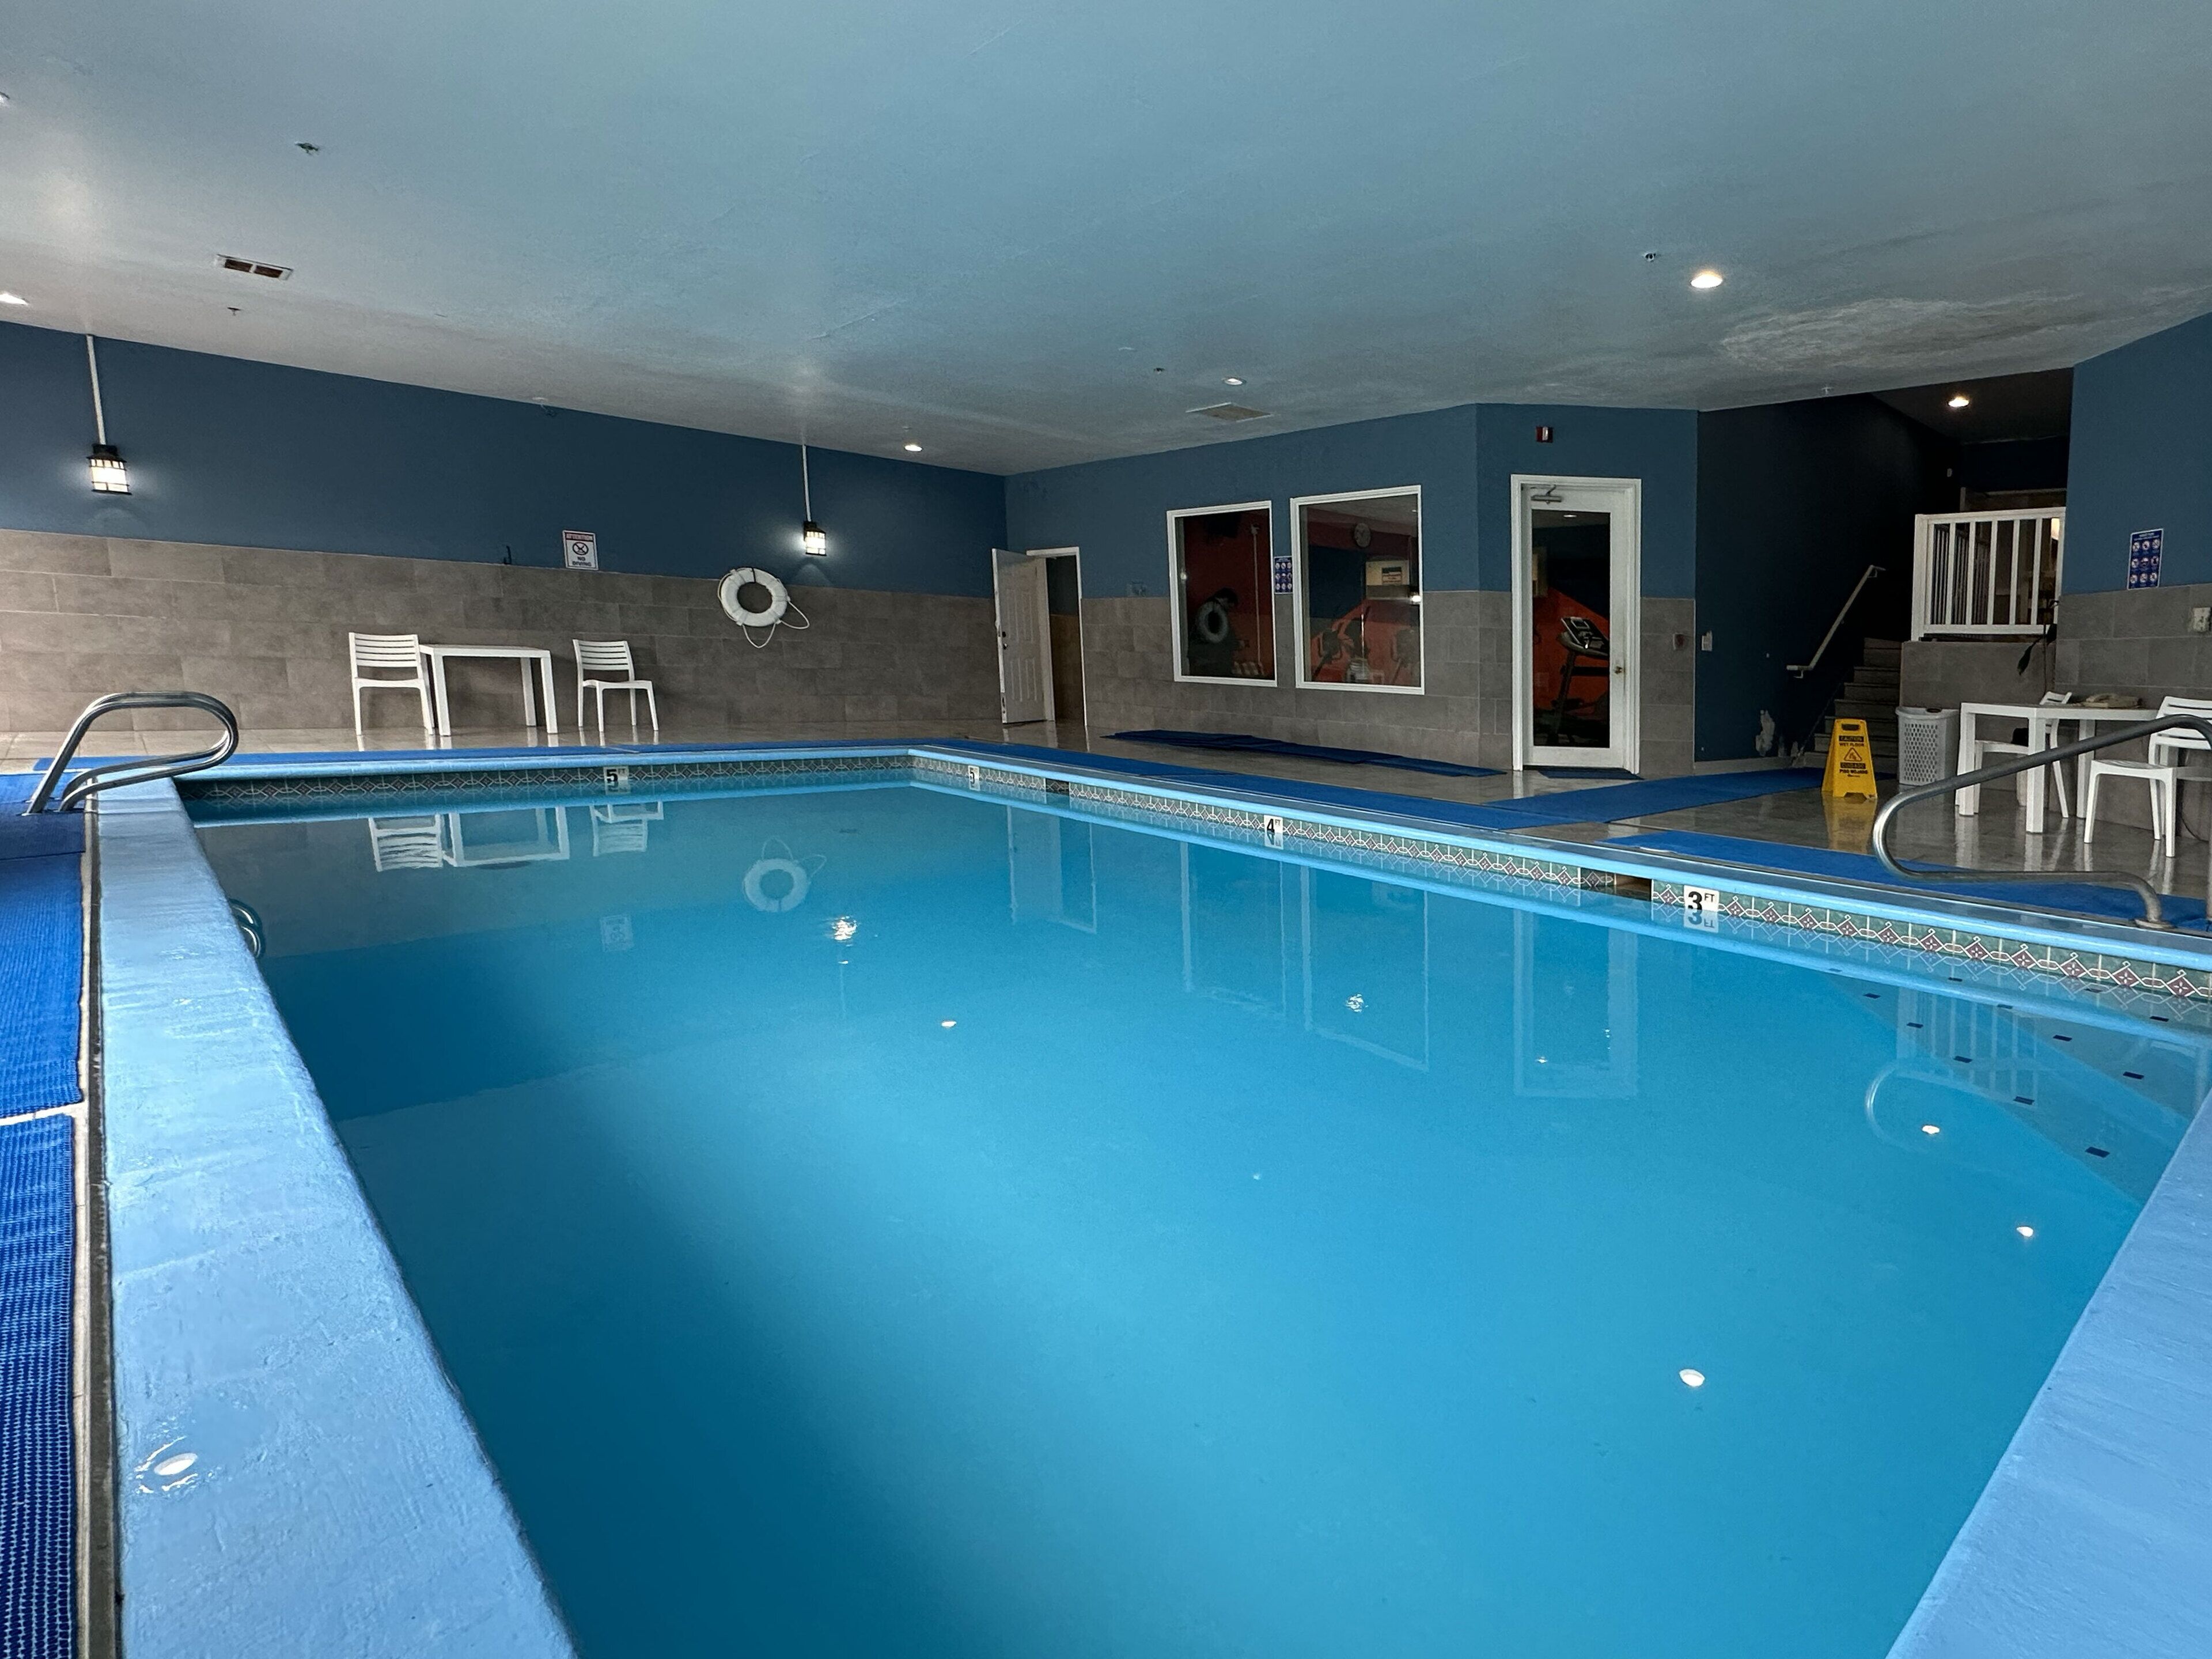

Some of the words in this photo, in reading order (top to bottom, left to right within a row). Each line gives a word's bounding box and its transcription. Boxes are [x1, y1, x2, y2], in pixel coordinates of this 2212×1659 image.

[607, 769, 618, 782] 5
[969, 767, 975, 779] 5
[1267, 819, 1275, 832] 4
[1688, 891, 1702, 911] 3
[1705, 893, 1715, 902] FT
